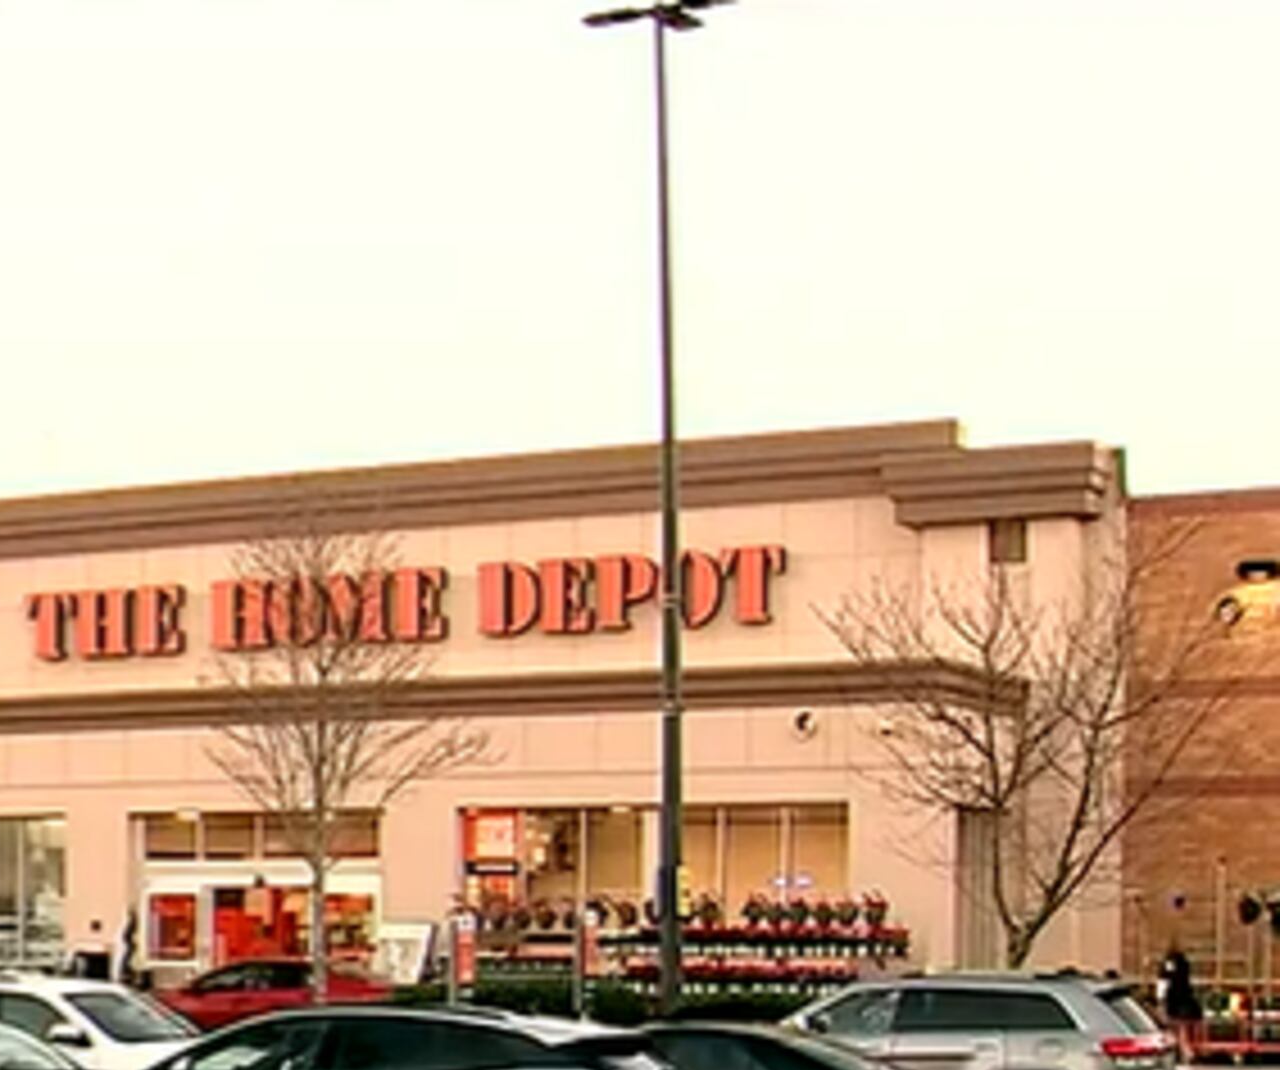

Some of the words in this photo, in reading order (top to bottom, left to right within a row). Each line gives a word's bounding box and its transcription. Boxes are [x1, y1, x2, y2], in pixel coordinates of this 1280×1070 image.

[25, 584, 186, 662] THE
[209, 566, 448, 652] HOME
[476, 545, 786, 638] DEPOT
